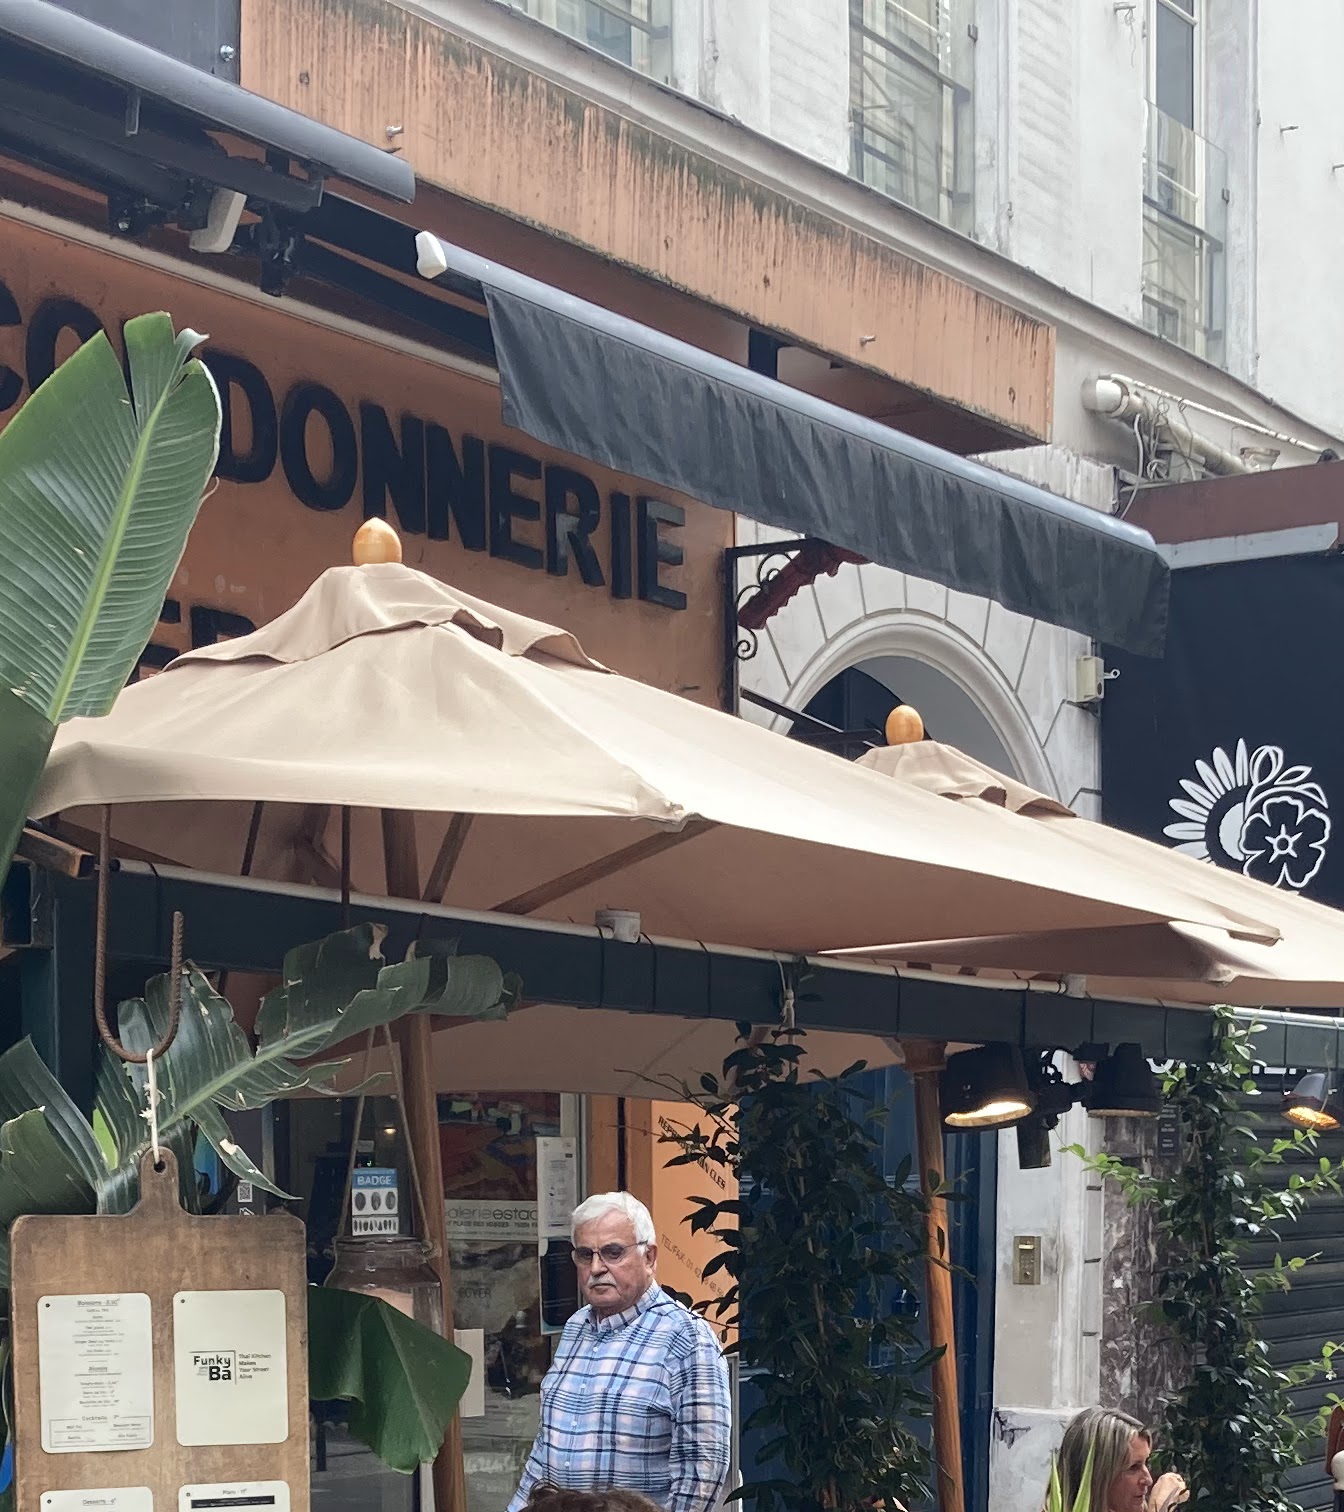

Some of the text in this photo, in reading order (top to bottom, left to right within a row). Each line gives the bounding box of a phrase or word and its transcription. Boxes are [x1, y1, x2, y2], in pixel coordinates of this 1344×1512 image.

[357, 1175, 392, 1186] BADGE
[193, 1354, 231, 1368] Funky
[209, 1365, 232, 1381] Ba
